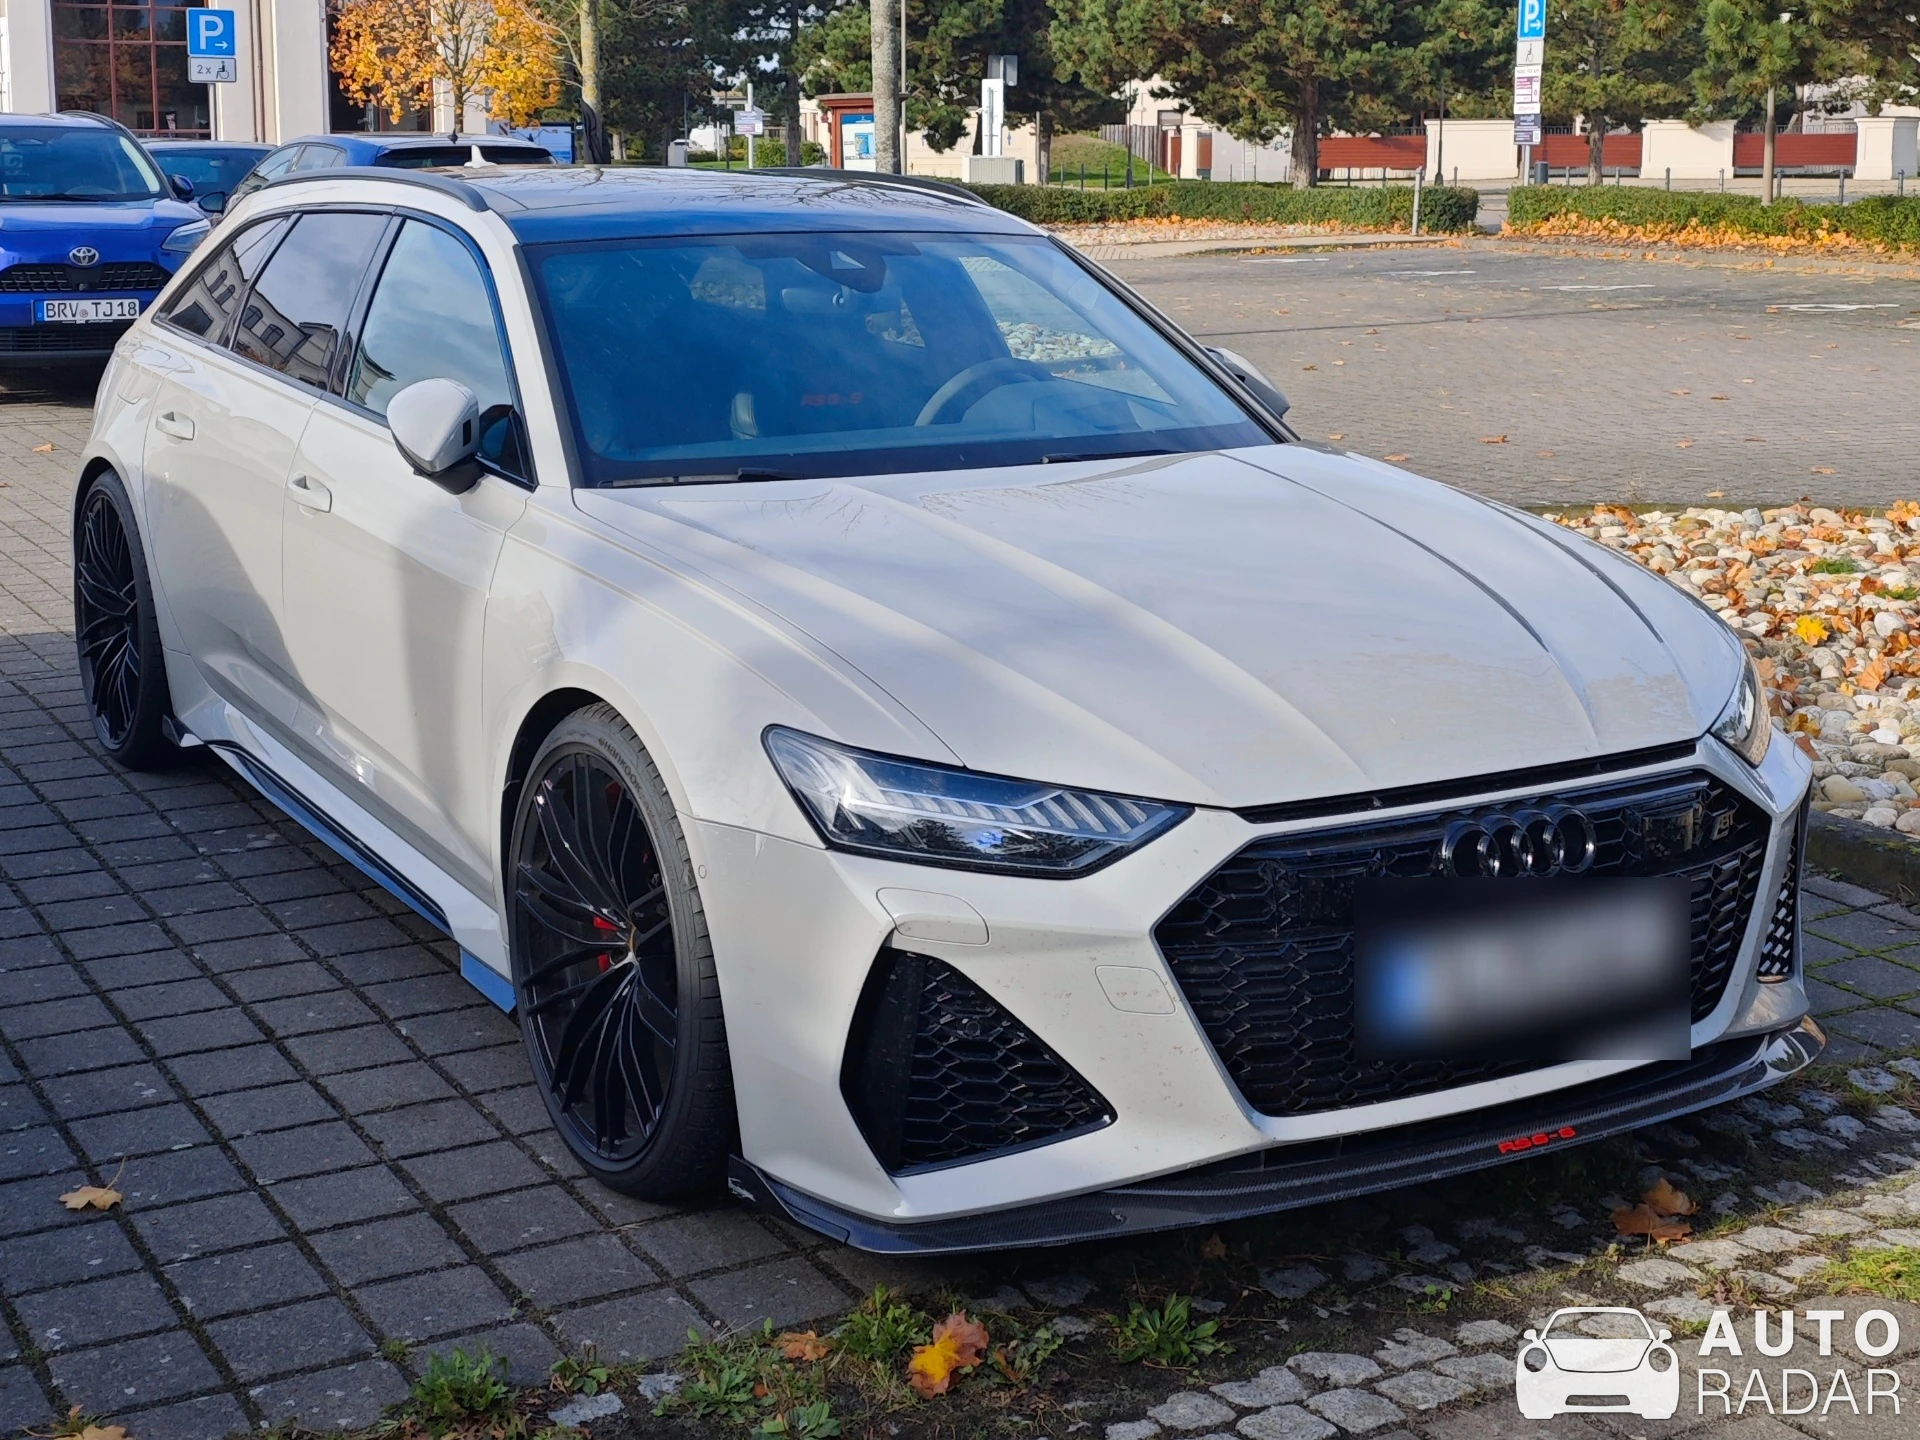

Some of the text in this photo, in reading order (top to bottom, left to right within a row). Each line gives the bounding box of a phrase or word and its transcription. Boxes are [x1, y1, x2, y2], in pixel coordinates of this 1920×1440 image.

[199, 15, 224, 50] P
[1524, 0, 1540, 33] P
[45, 302, 79, 318] BRV
